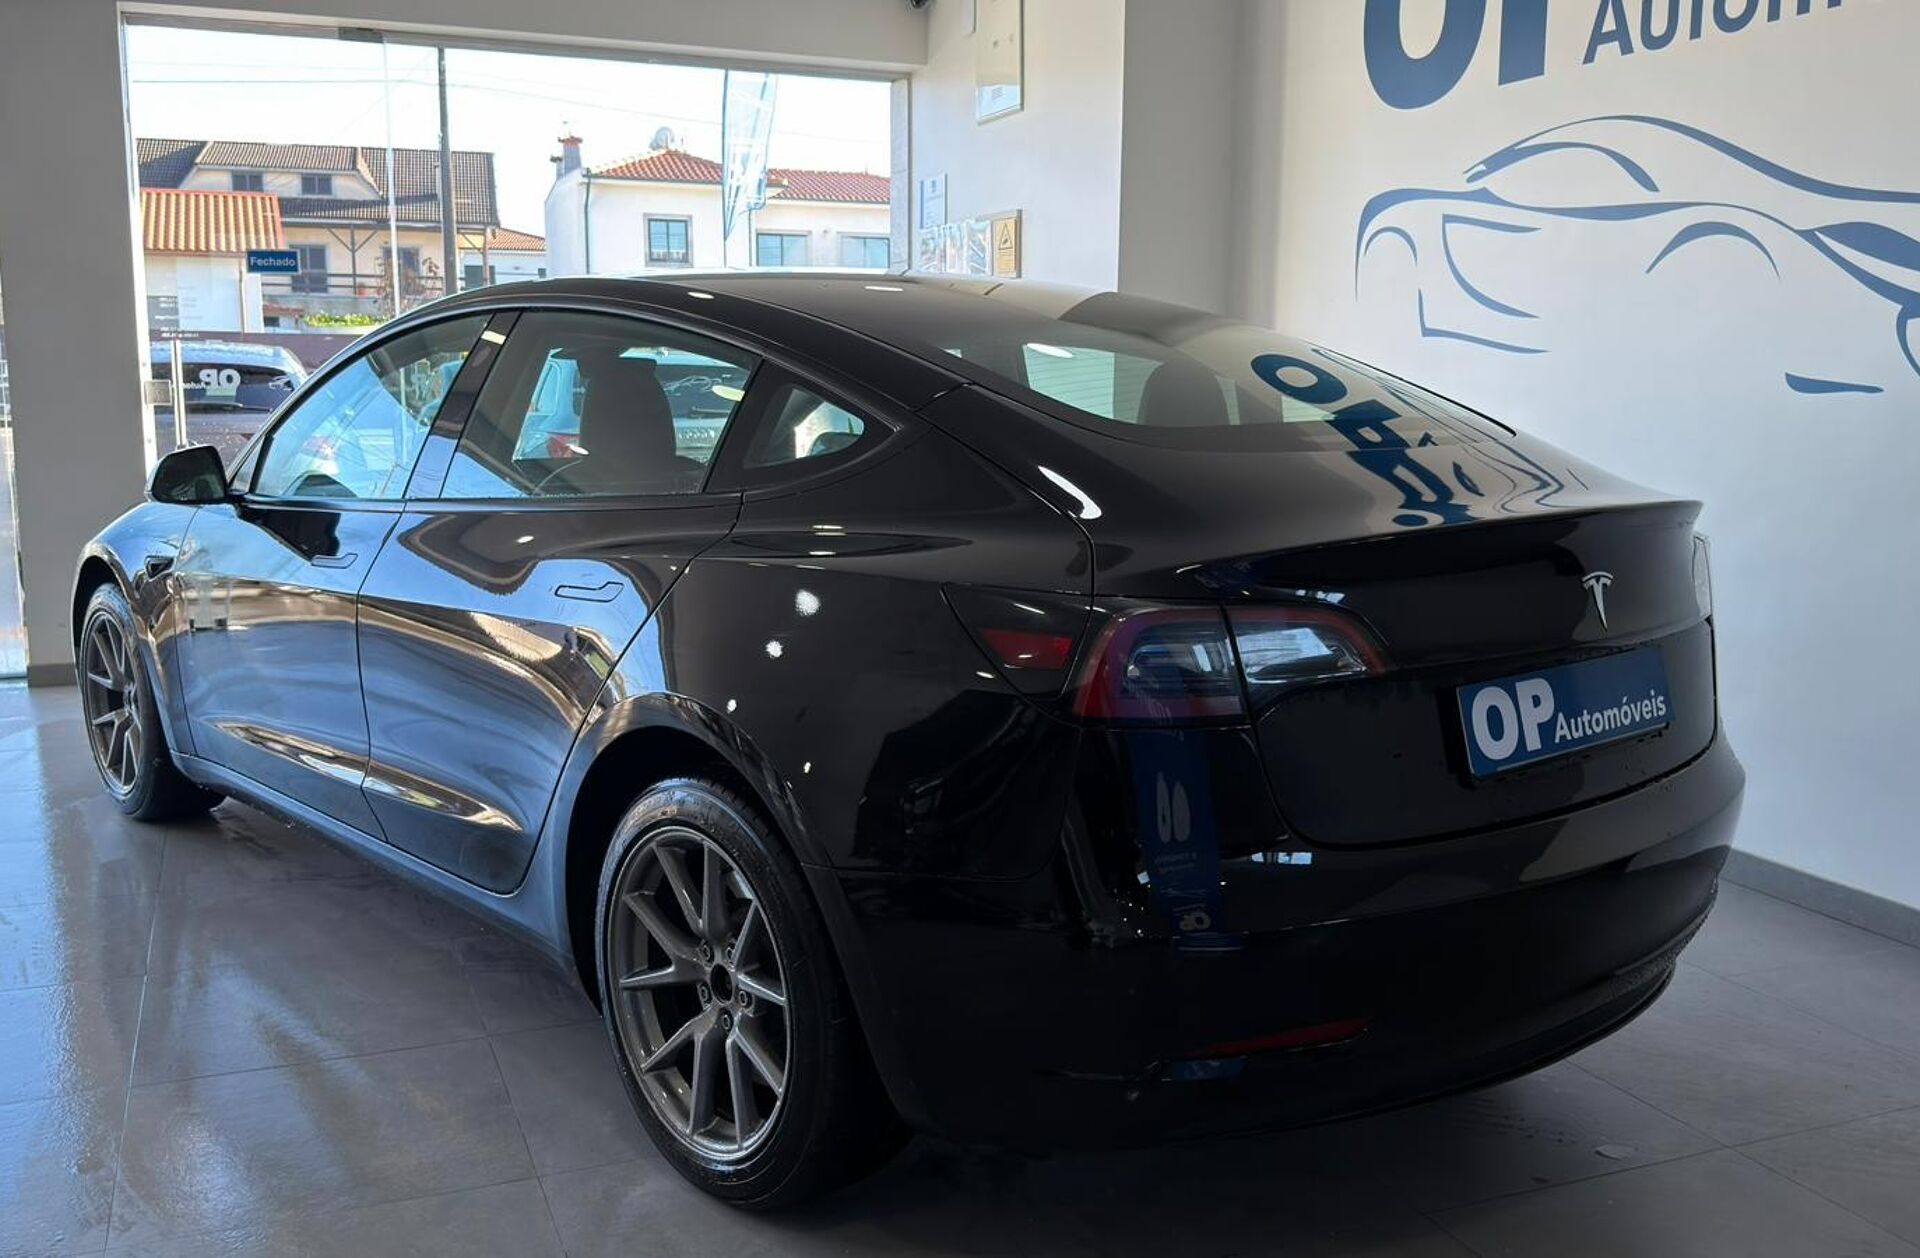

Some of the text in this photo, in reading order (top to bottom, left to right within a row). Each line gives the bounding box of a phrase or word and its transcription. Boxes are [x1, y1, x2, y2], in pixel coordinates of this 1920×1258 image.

[250, 256, 296, 267] Fechado
[1472, 678, 1667, 760] OP Automóveis
